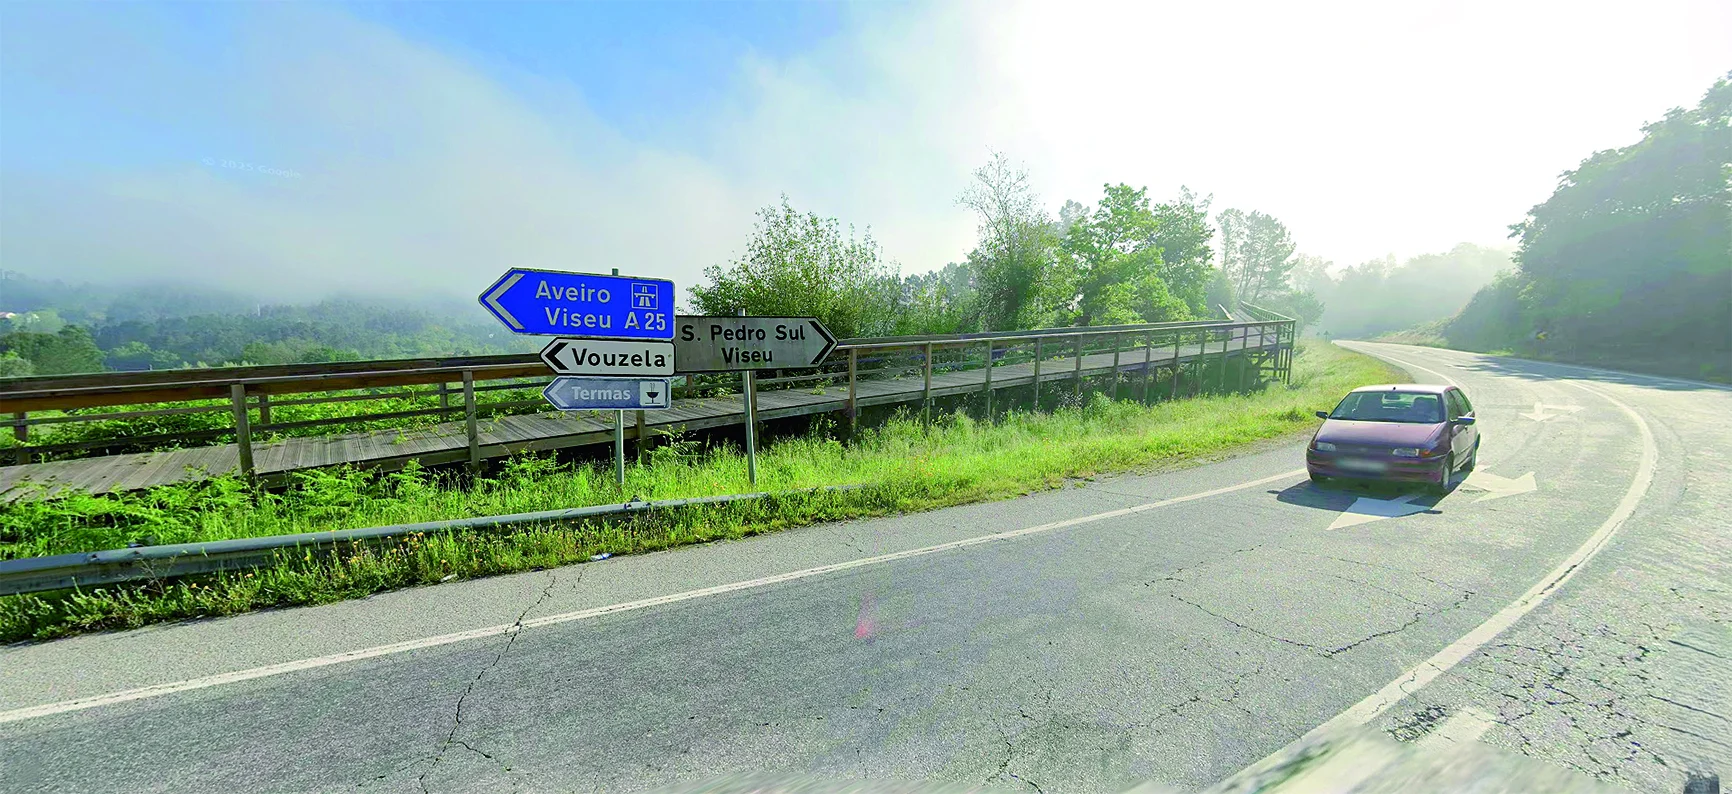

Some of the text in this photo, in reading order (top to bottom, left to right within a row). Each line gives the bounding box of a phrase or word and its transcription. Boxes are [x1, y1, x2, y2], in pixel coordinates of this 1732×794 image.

[535, 280, 611, 303] Aveiro
[544, 306, 611, 329] Viseu
[681, 324, 806, 342] S. Pedro Sul
[571, 347, 666, 368] Vouzela
[721, 346, 773, 364] Viseu
[571, 385, 631, 401] Termas
